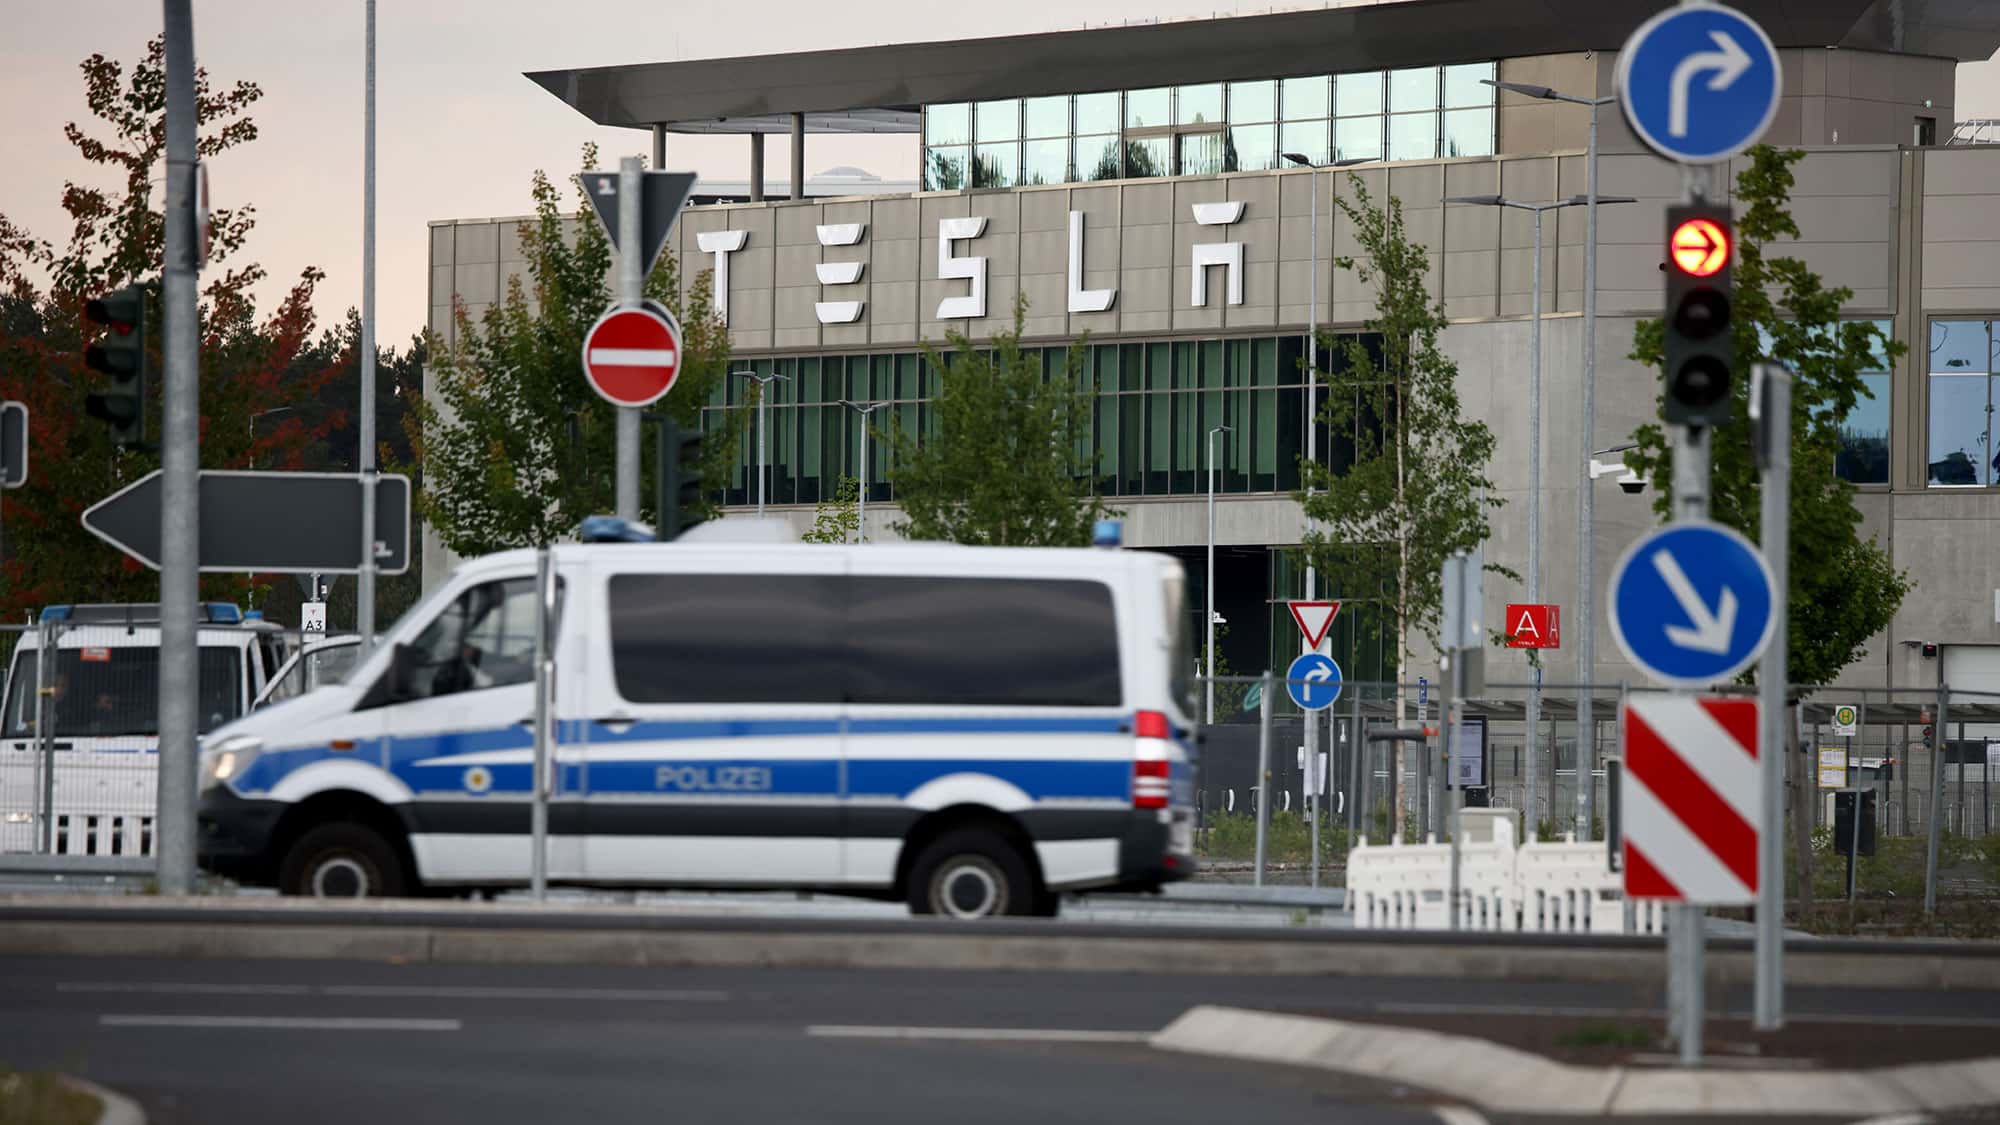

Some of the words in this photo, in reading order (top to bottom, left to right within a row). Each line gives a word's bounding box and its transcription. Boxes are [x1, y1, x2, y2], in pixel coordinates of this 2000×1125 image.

[696, 200, 1247, 329] TESLA
[305, 619, 322, 631] A3
[1514, 610, 1540, 639] A
[655, 766, 772, 791] POLIZEI
